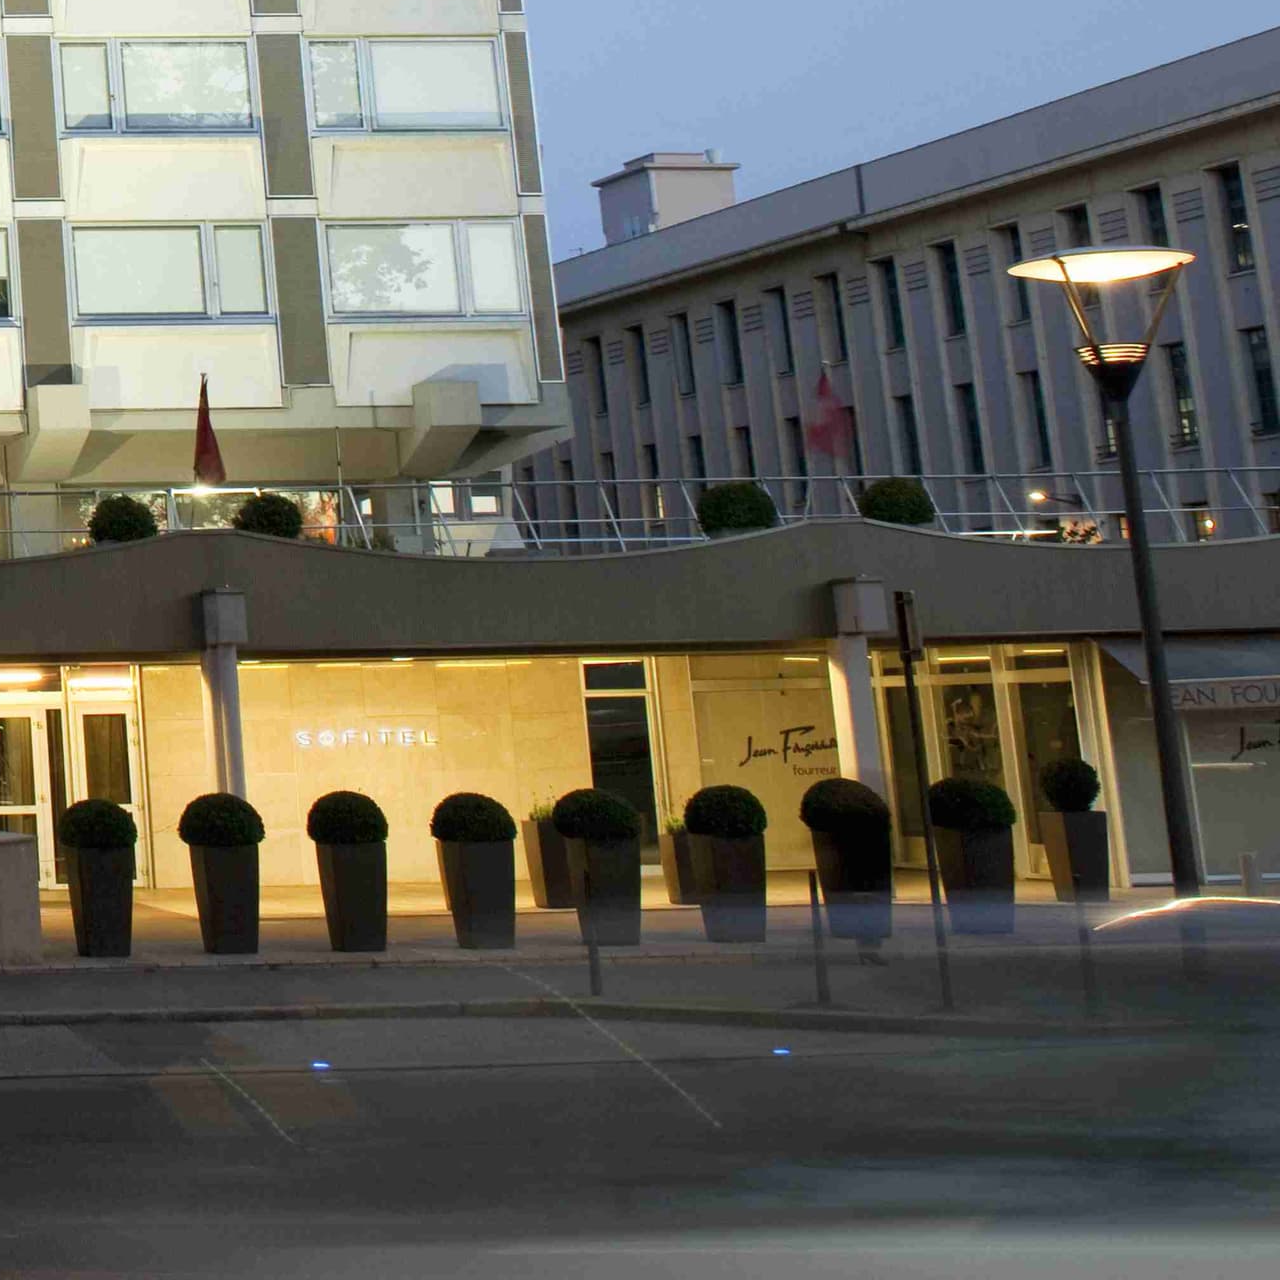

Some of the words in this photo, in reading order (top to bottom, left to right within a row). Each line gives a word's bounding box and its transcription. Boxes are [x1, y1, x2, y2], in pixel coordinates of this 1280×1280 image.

[1168, 685, 1216, 705] EAN
[1230, 683, 1280, 704] FOU
[296, 729, 439, 747] SOFITEL
[739, 735, 778, 767] Jean
[792, 763, 836, 776] fourreur
